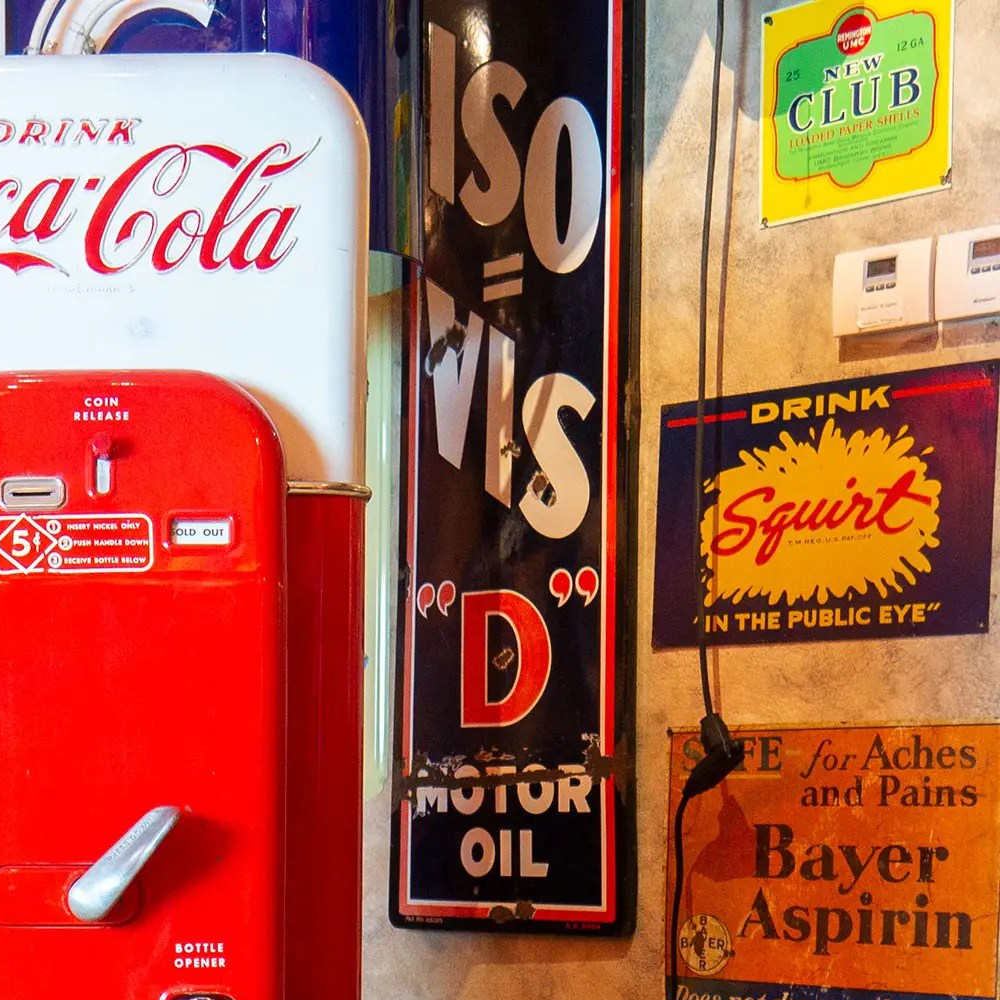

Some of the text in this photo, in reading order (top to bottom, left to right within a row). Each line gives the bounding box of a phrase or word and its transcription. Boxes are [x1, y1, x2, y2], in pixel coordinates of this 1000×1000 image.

[842, 37, 865, 50] UMC
[785, 69, 800, 82] 25
[824, 54, 884, 82] NEW
[788, 67, 922, 132] CLUB
[789, 130, 835, 149] LOADED
[839, 120, 873, 137] PAPER
[877, 108, 920, 126] SHELLS
[429, 21, 602, 274] ISO
[74, 411, 129, 421] RELEASE
[84, 397, 119, 407] COIN
[425, 278, 597, 539] VIS
[751, 385, 891, 425] DRINK
[121, 521, 141, 530] ONLY
[203, 528, 224, 537] OUT
[710, 470, 932, 566] Squirt
[11, 529, 41, 558] 5¢
[64, 557, 92, 565] RECEIVE
[735, 612, 780, 632] THE
[788, 606, 871, 629] PUBLIC
[682, 733, 977, 779] SFE for Aches
[416, 763, 593, 815] MOTOR
[801, 774, 978, 808] and Pains
[460, 827, 549, 878] OIL
[753, 823, 949, 895] Bayer
[737, 887, 973, 956] Aspirin
[175, 943, 224, 953] BOTTLE
[680, 937, 726, 951] BER
[174, 957, 226, 968] OPENER
